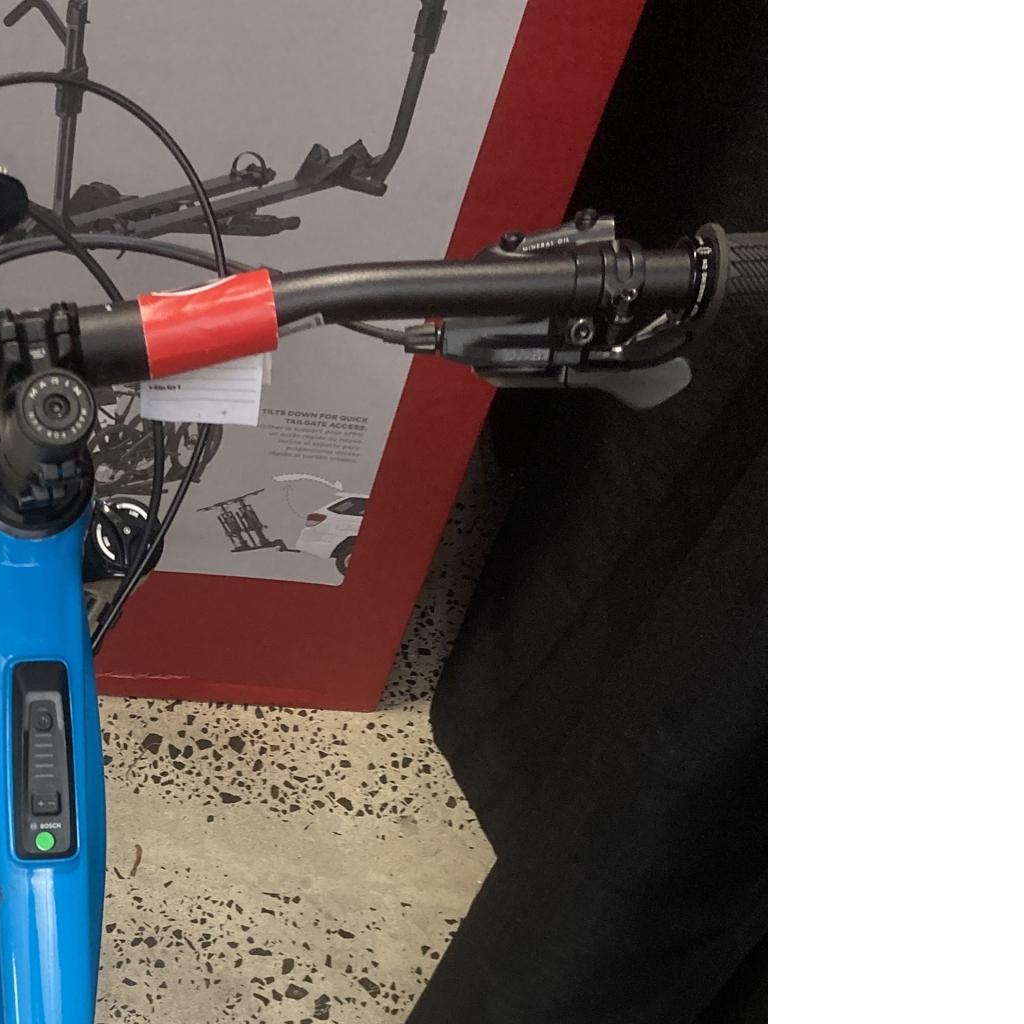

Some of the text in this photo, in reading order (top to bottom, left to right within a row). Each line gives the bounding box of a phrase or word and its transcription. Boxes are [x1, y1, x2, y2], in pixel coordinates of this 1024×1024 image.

[522, 237, 570, 252] MINERAL OIL
[29, 376, 82, 400] MARIN
[262, 408, 286, 416] TILTS
[288, 410, 317, 418] DOWN
[339, 415, 368, 423] QUICK
[286, 418, 327, 427] TAILGATE
[40, 822, 62, 830] BOSCH
